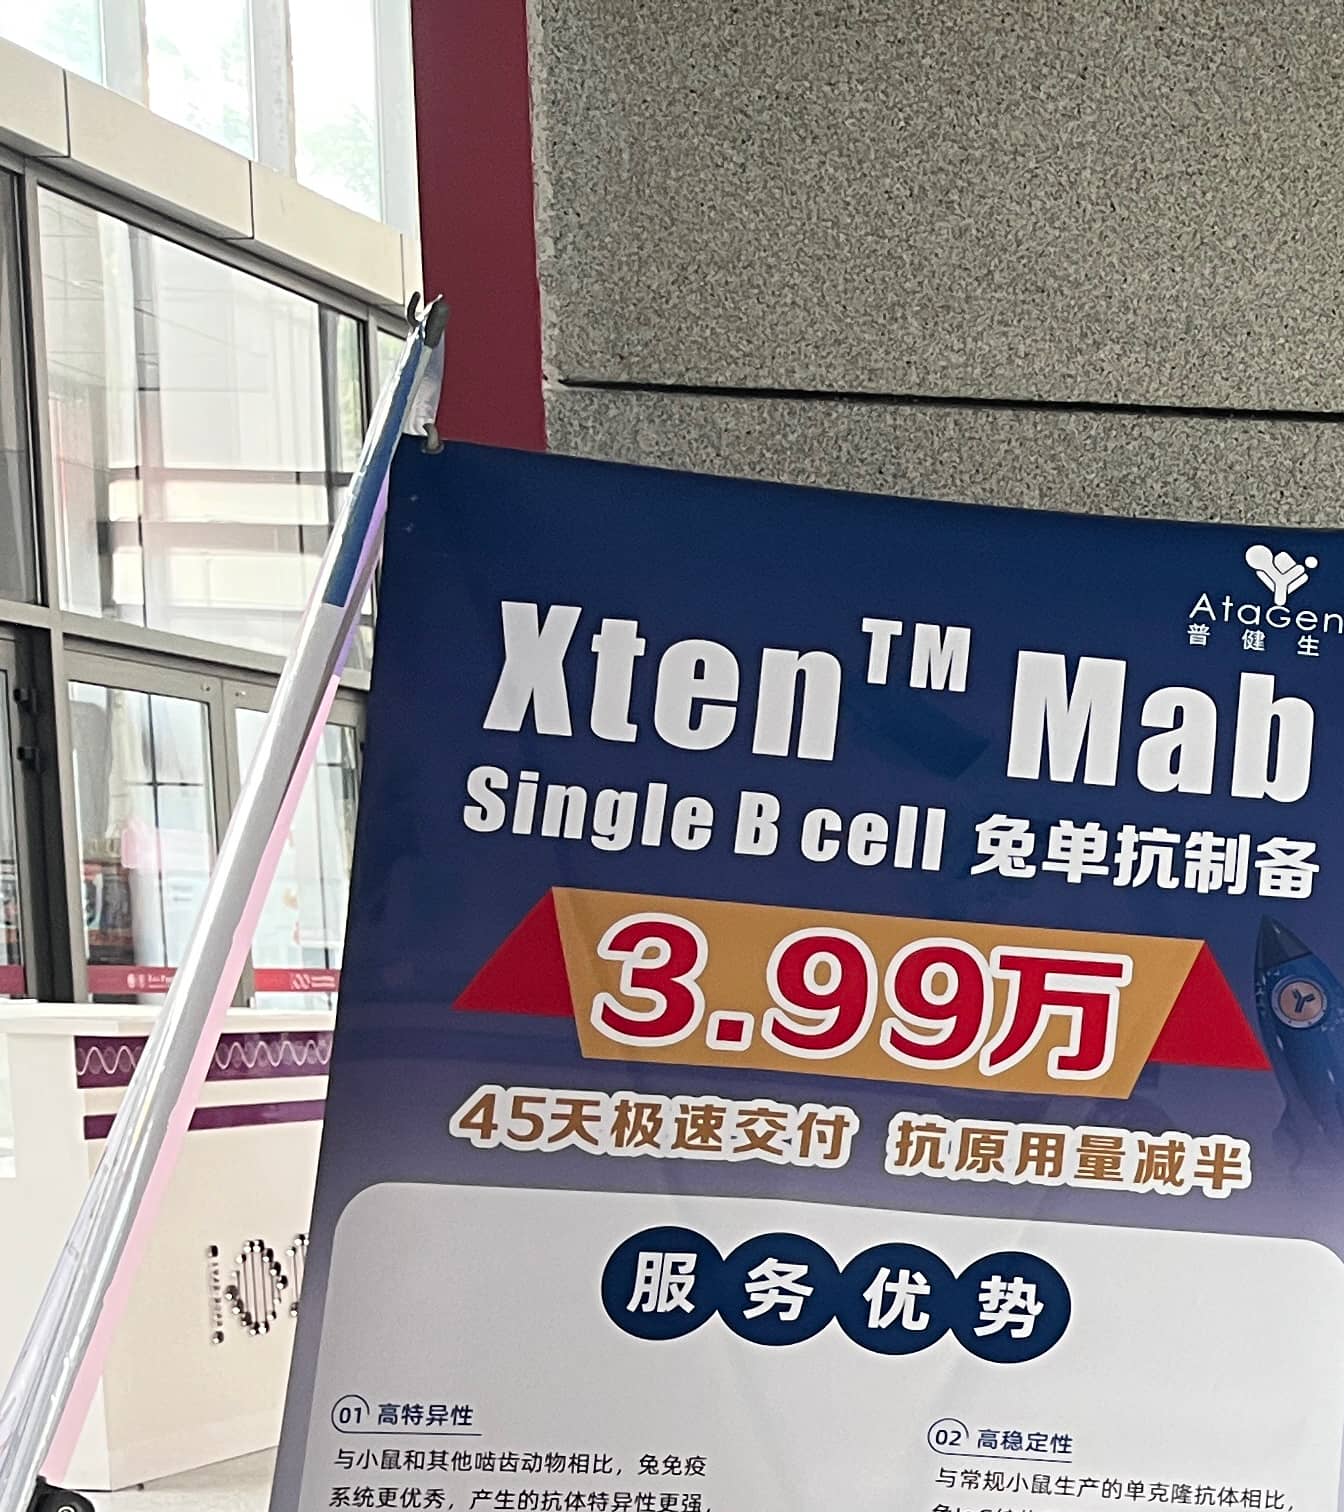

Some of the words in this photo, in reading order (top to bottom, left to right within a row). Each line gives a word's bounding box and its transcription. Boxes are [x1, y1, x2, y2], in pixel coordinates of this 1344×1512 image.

[1006, 649, 1317, 804] Mab
[464, 765, 714, 847] Single
[735, 797, 779, 858] B
[801, 806, 946, 873] cell
[970, 814, 1321, 900] 兔单抗制备
[592, 911, 1132, 1081] 3.99万
[451, 1086, 858, 1168] 45天极速交付
[886, 1114, 1251, 1196] 抗原用量减半
[626, 1251, 1045, 1339] 服务优势
[338, 1405, 363, 1425] 01
[377, 1403, 474, 1427] 高特异性
[934, 1429, 962, 1447] 02
[976, 1428, 1073, 1455] 高稳定性
